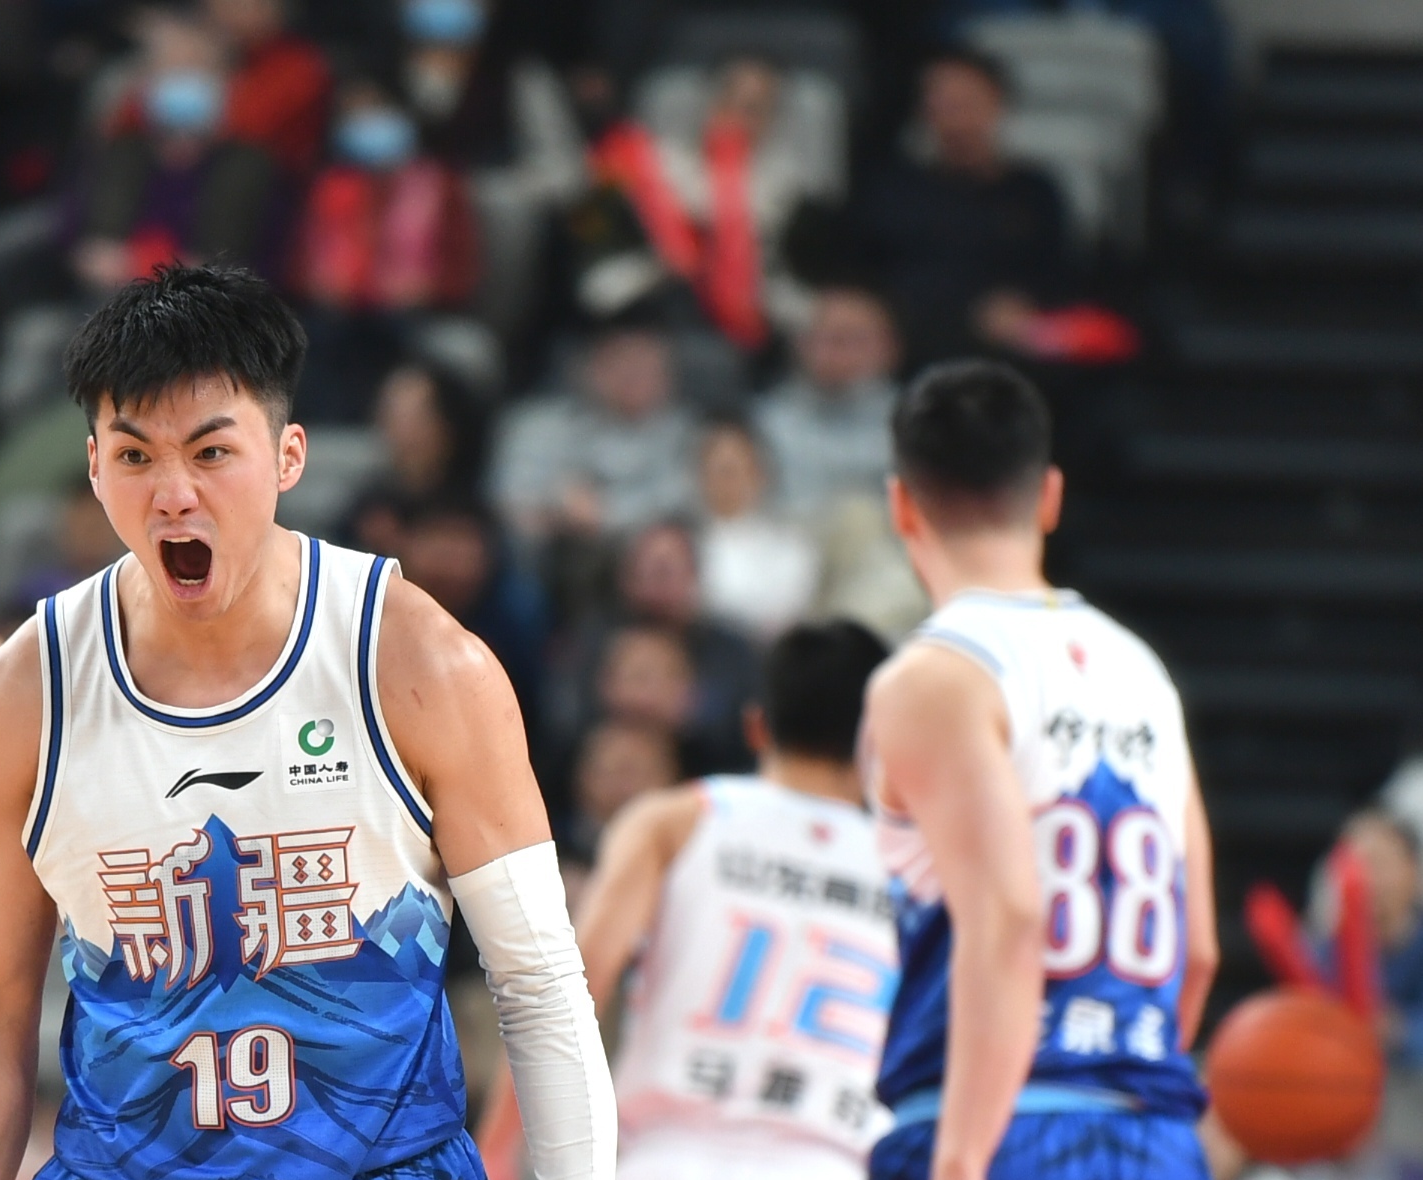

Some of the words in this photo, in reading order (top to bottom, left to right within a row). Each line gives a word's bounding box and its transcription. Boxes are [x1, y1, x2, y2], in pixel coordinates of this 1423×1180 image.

[288, 761, 349, 778] 中国人寿
[289, 777, 324, 787] CHINA
[326, 774, 350, 783] LIFE
[96, 825, 365, 991] 新疆
[1033, 797, 1179, 987] 88
[687, 903, 901, 1070] 12
[168, 1024, 297, 1131] 19
